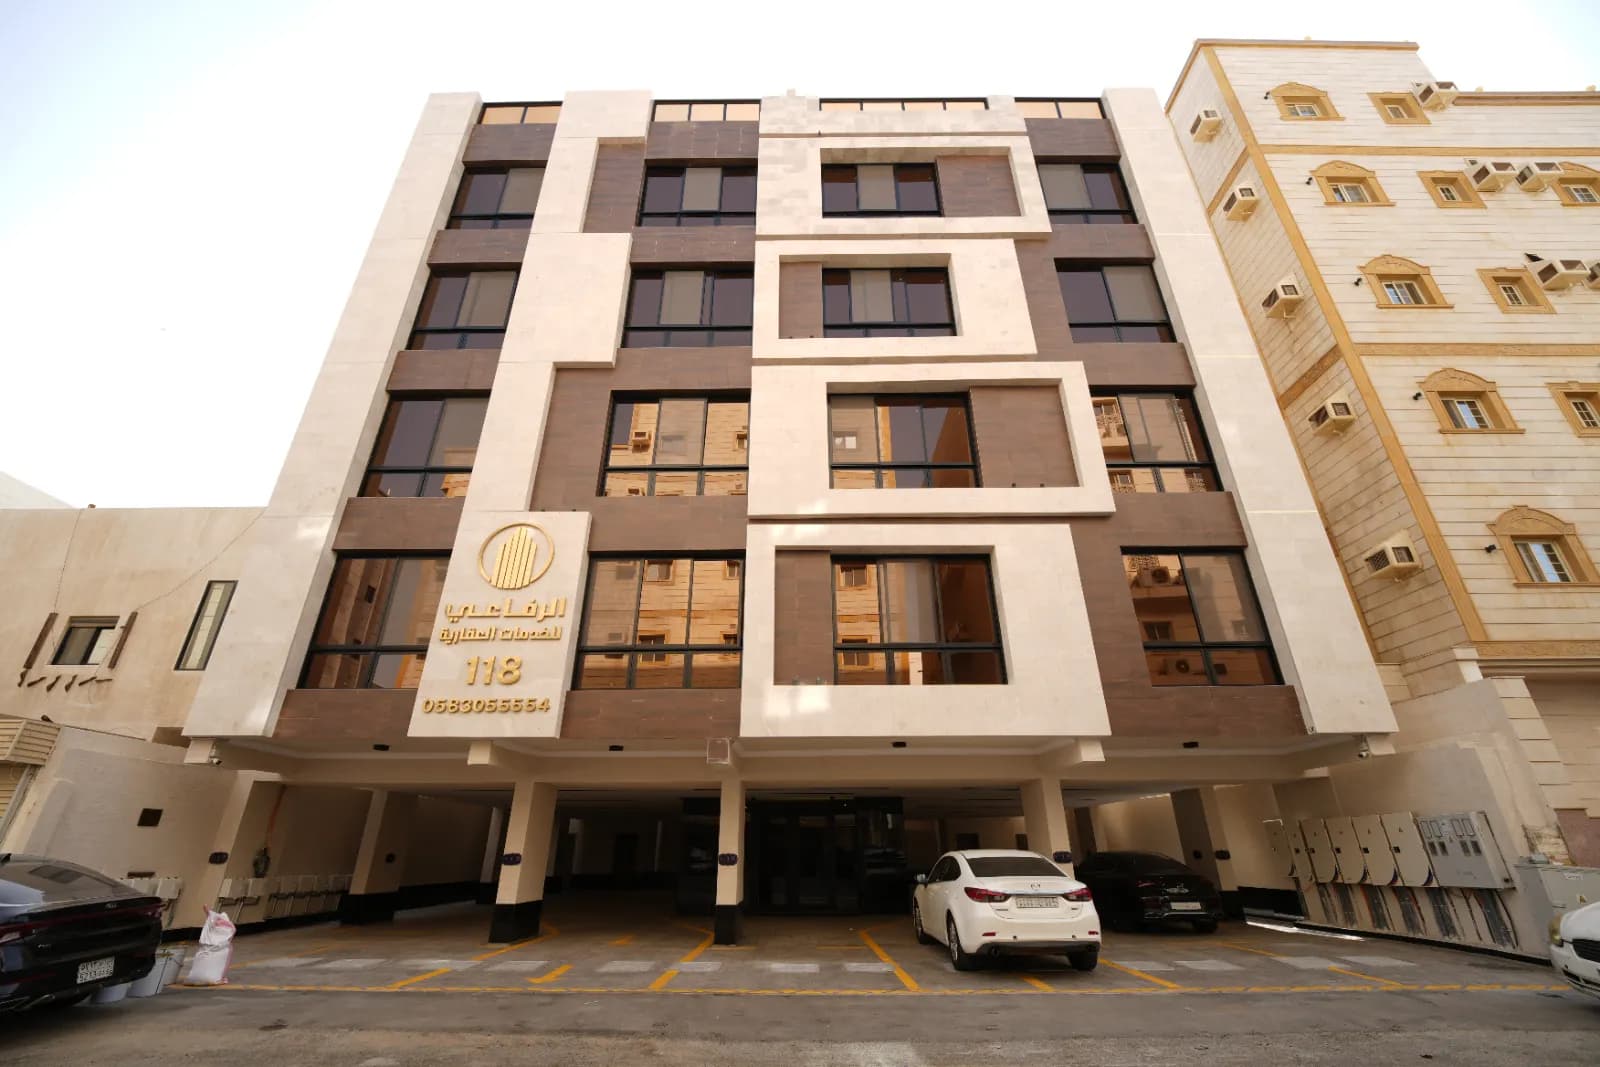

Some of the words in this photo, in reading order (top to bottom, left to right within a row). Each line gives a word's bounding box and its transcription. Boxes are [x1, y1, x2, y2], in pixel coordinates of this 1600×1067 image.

[445, 597, 567, 623] الرفاعي
[439, 626, 497, 645] العقارية
[499, 626, 562, 641] للخدمات
[465, 656, 522, 686] 118
[423, 698, 550, 714] 0583055554
